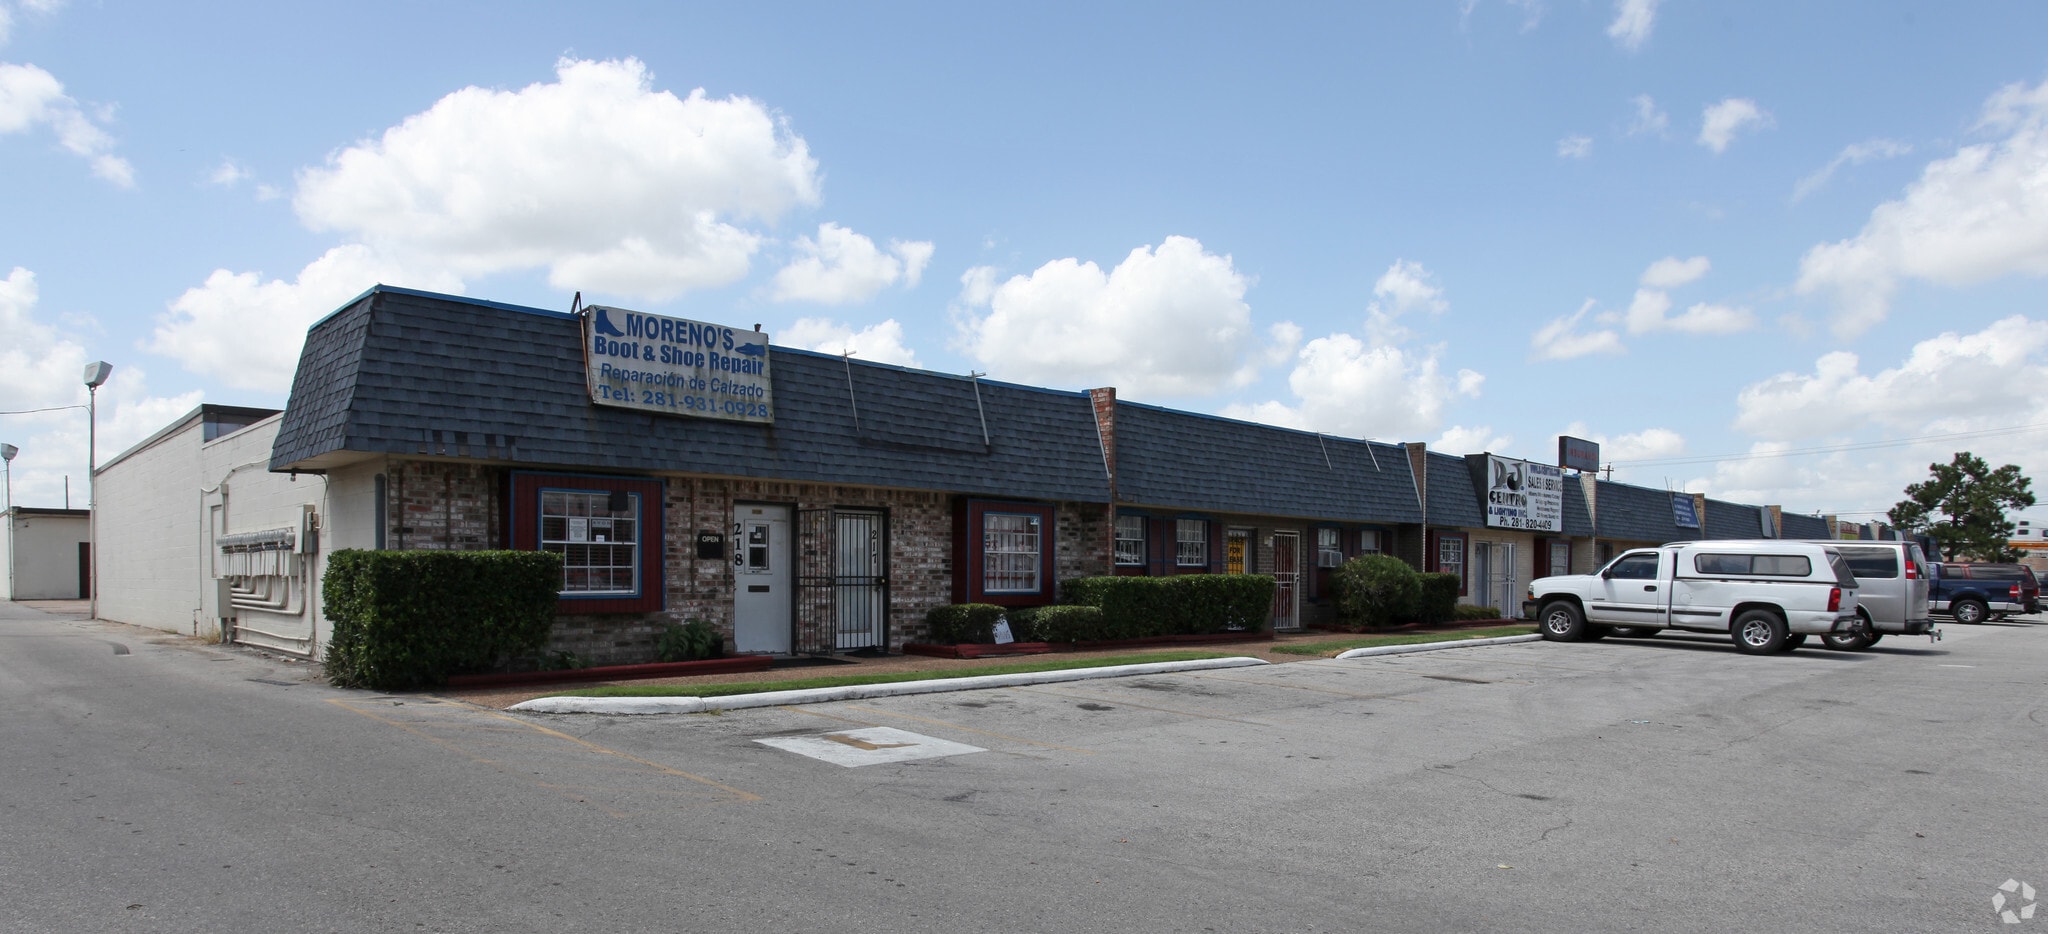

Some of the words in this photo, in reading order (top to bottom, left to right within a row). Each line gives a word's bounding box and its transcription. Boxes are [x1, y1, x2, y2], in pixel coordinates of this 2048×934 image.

[626, 312, 735, 351] MORENO'S
[594, 335, 639, 360] Boot
[643, 346, 656, 362] &
[660, 343, 705, 368] Shoe
[709, 351, 764, 376] Repair
[601, 362, 685, 390] Reparación
[689, 375, 706, 391] de
[710, 377, 764, 398] Calzado
[598, 384, 635, 403] Tel:
[642, 389, 768, 418] 281-931-0928
[1527, 475, 1542, 490] SALES
[1545, 478, 1562, 493] SERVICE
[1489, 491, 1527, 507] CENTRO
[1494, 507, 1517, 517] LIGHTING
[1499, 516, 1510, 527] Ph.
[701, 535, 720, 543] OPEN
